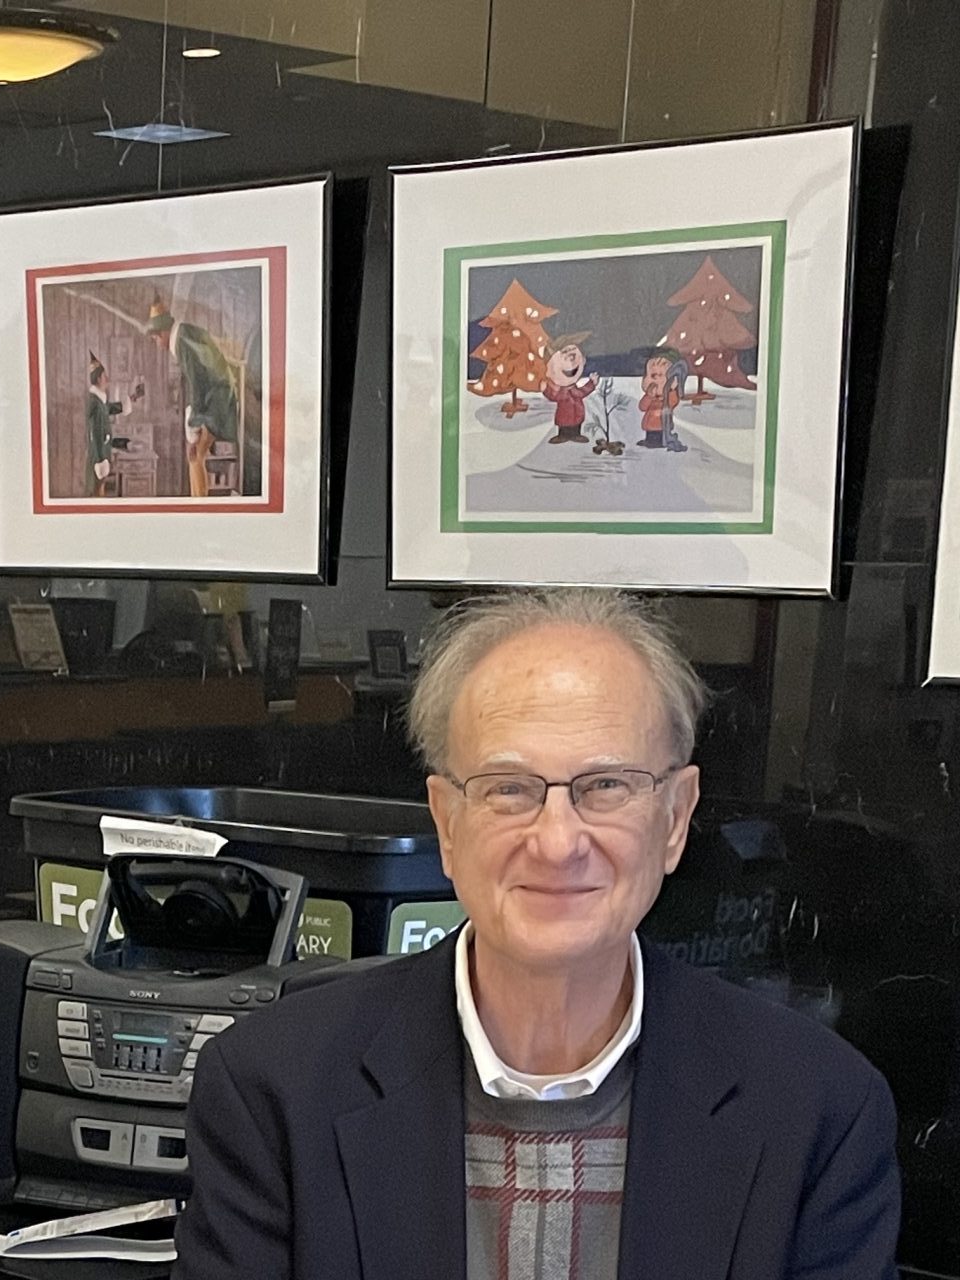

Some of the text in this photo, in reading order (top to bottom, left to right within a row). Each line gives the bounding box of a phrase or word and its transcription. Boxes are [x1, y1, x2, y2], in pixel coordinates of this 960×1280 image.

[120, 833, 135, 845] No
[305, 916, 331, 928] PUBLIC
[296, 934, 332, 955] ARY
[128, 989, 161, 1000] SONY
